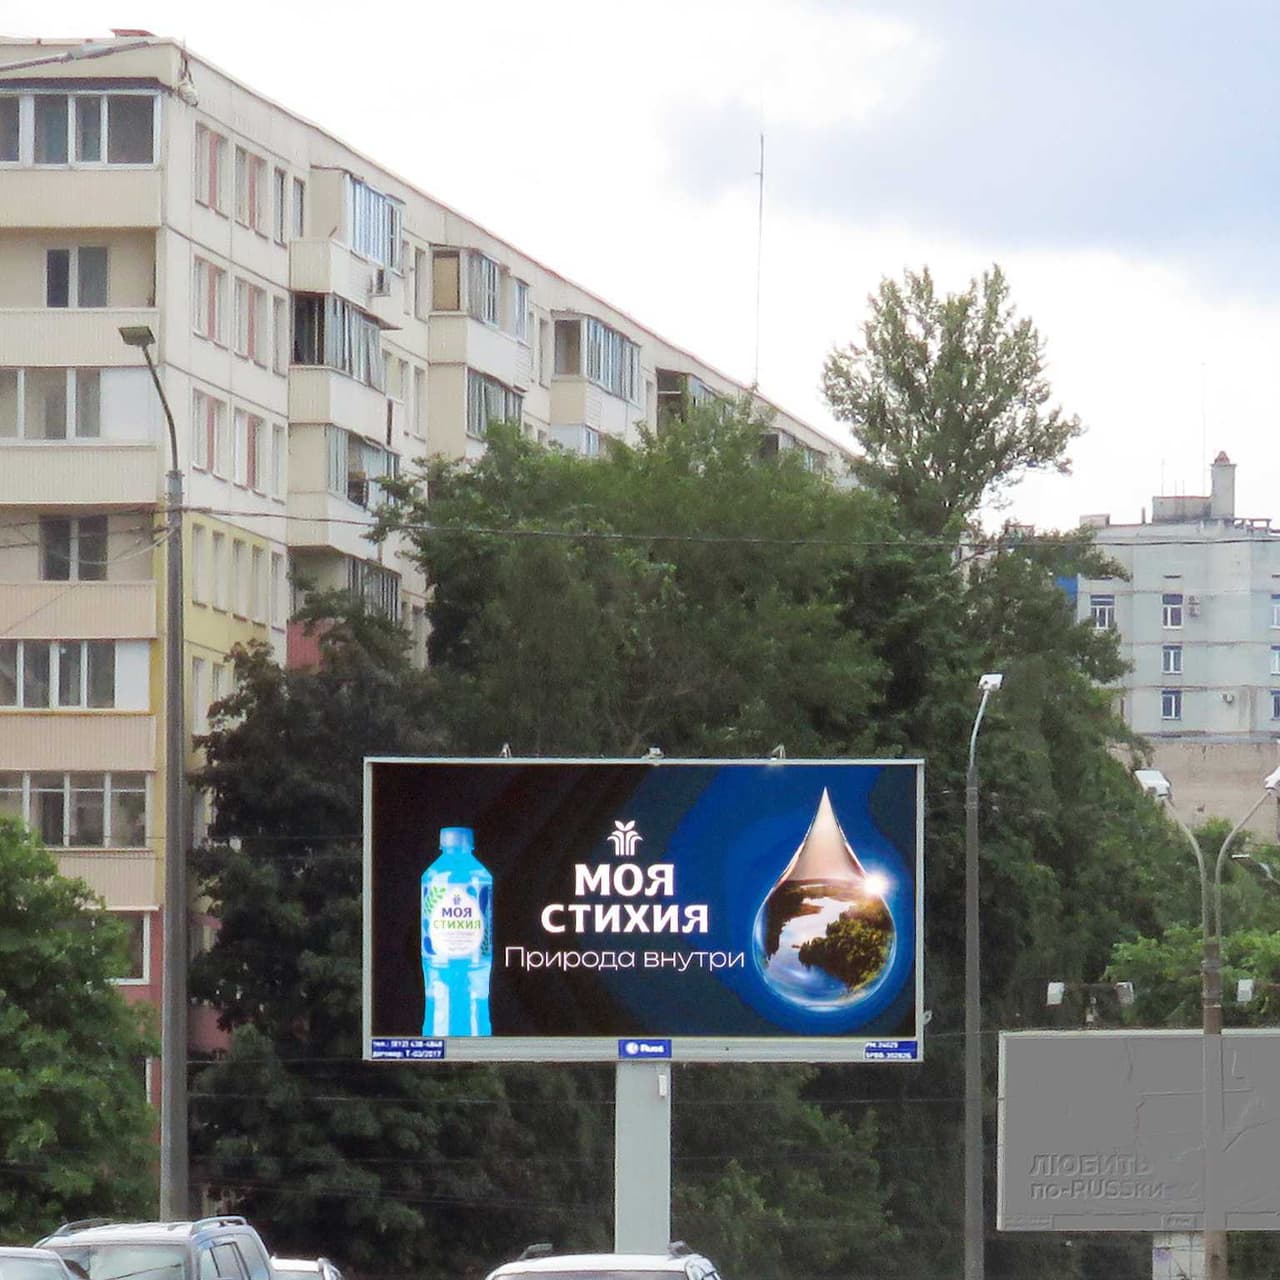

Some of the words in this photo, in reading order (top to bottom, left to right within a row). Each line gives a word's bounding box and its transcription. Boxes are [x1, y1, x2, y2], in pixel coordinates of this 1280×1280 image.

[574, 863, 675, 897] МОЯ
[433, 920, 481, 929] СТИХИЯ
[441, 907, 472, 918] МОЯ
[540, 903, 709, 934] СТИХИЯ
[505, 946, 636, 972] Природа
[644, 951, 745, 972] внутри
[1028, 1153, 1154, 1177] ЛЮБИТЬ
